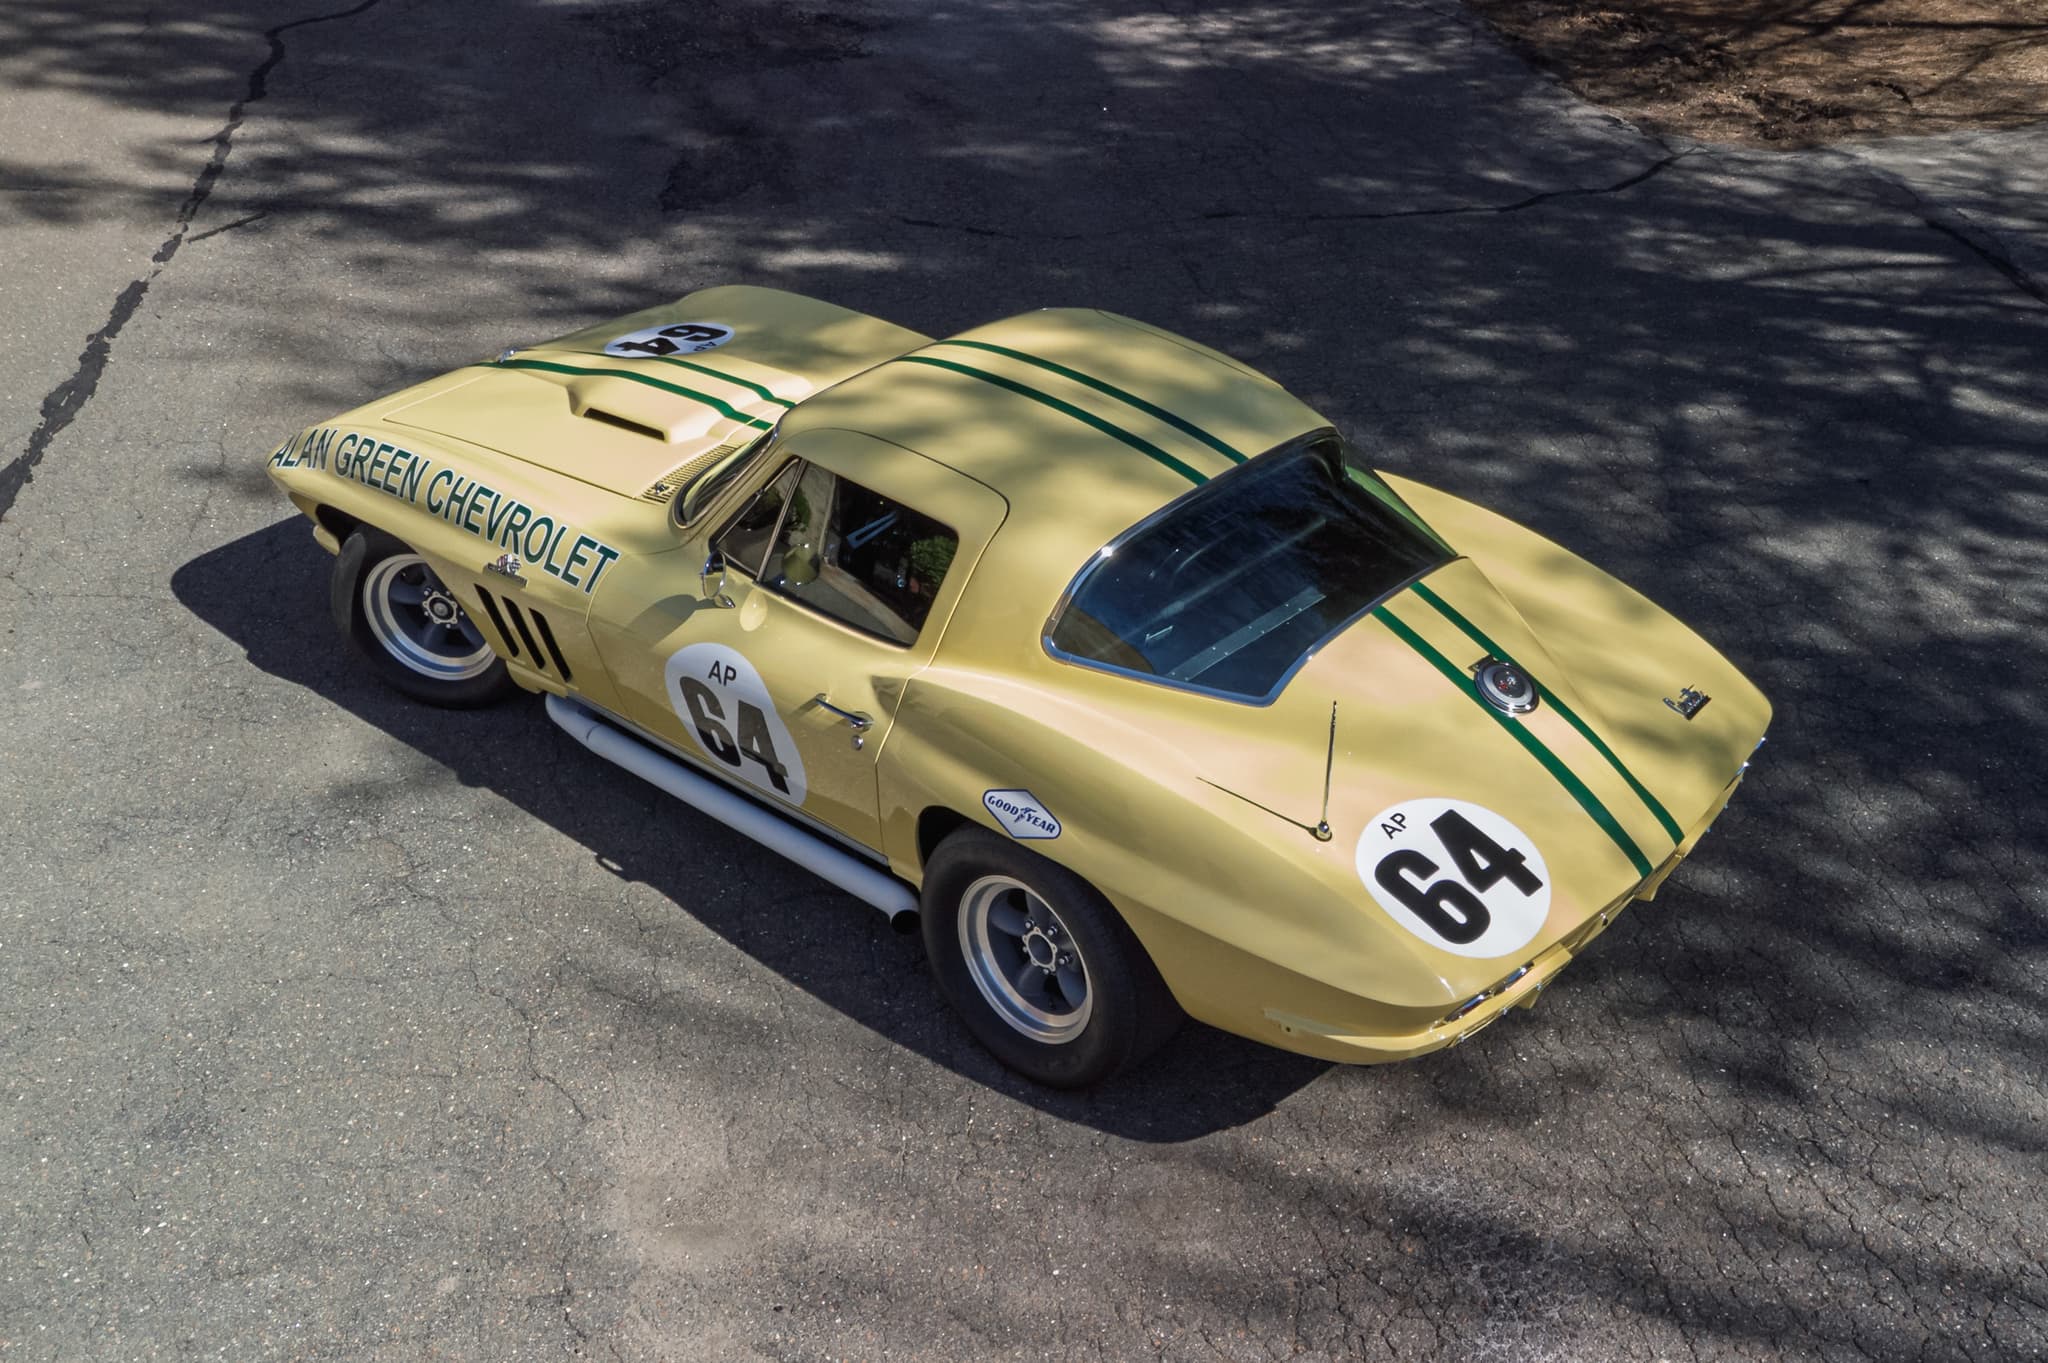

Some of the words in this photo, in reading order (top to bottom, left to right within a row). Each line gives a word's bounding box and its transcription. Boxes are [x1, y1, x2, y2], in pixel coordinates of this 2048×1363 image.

[614, 324, 728, 356] 64
[268, 428, 338, 469] ALAN
[333, 432, 431, 504] GREEN
[426, 468, 620, 594] CHEVROLET
[708, 660, 737, 686] AP
[679, 676, 791, 795] 64
[1380, 812, 1407, 840] AP
[1374, 809, 1543, 945] 64
